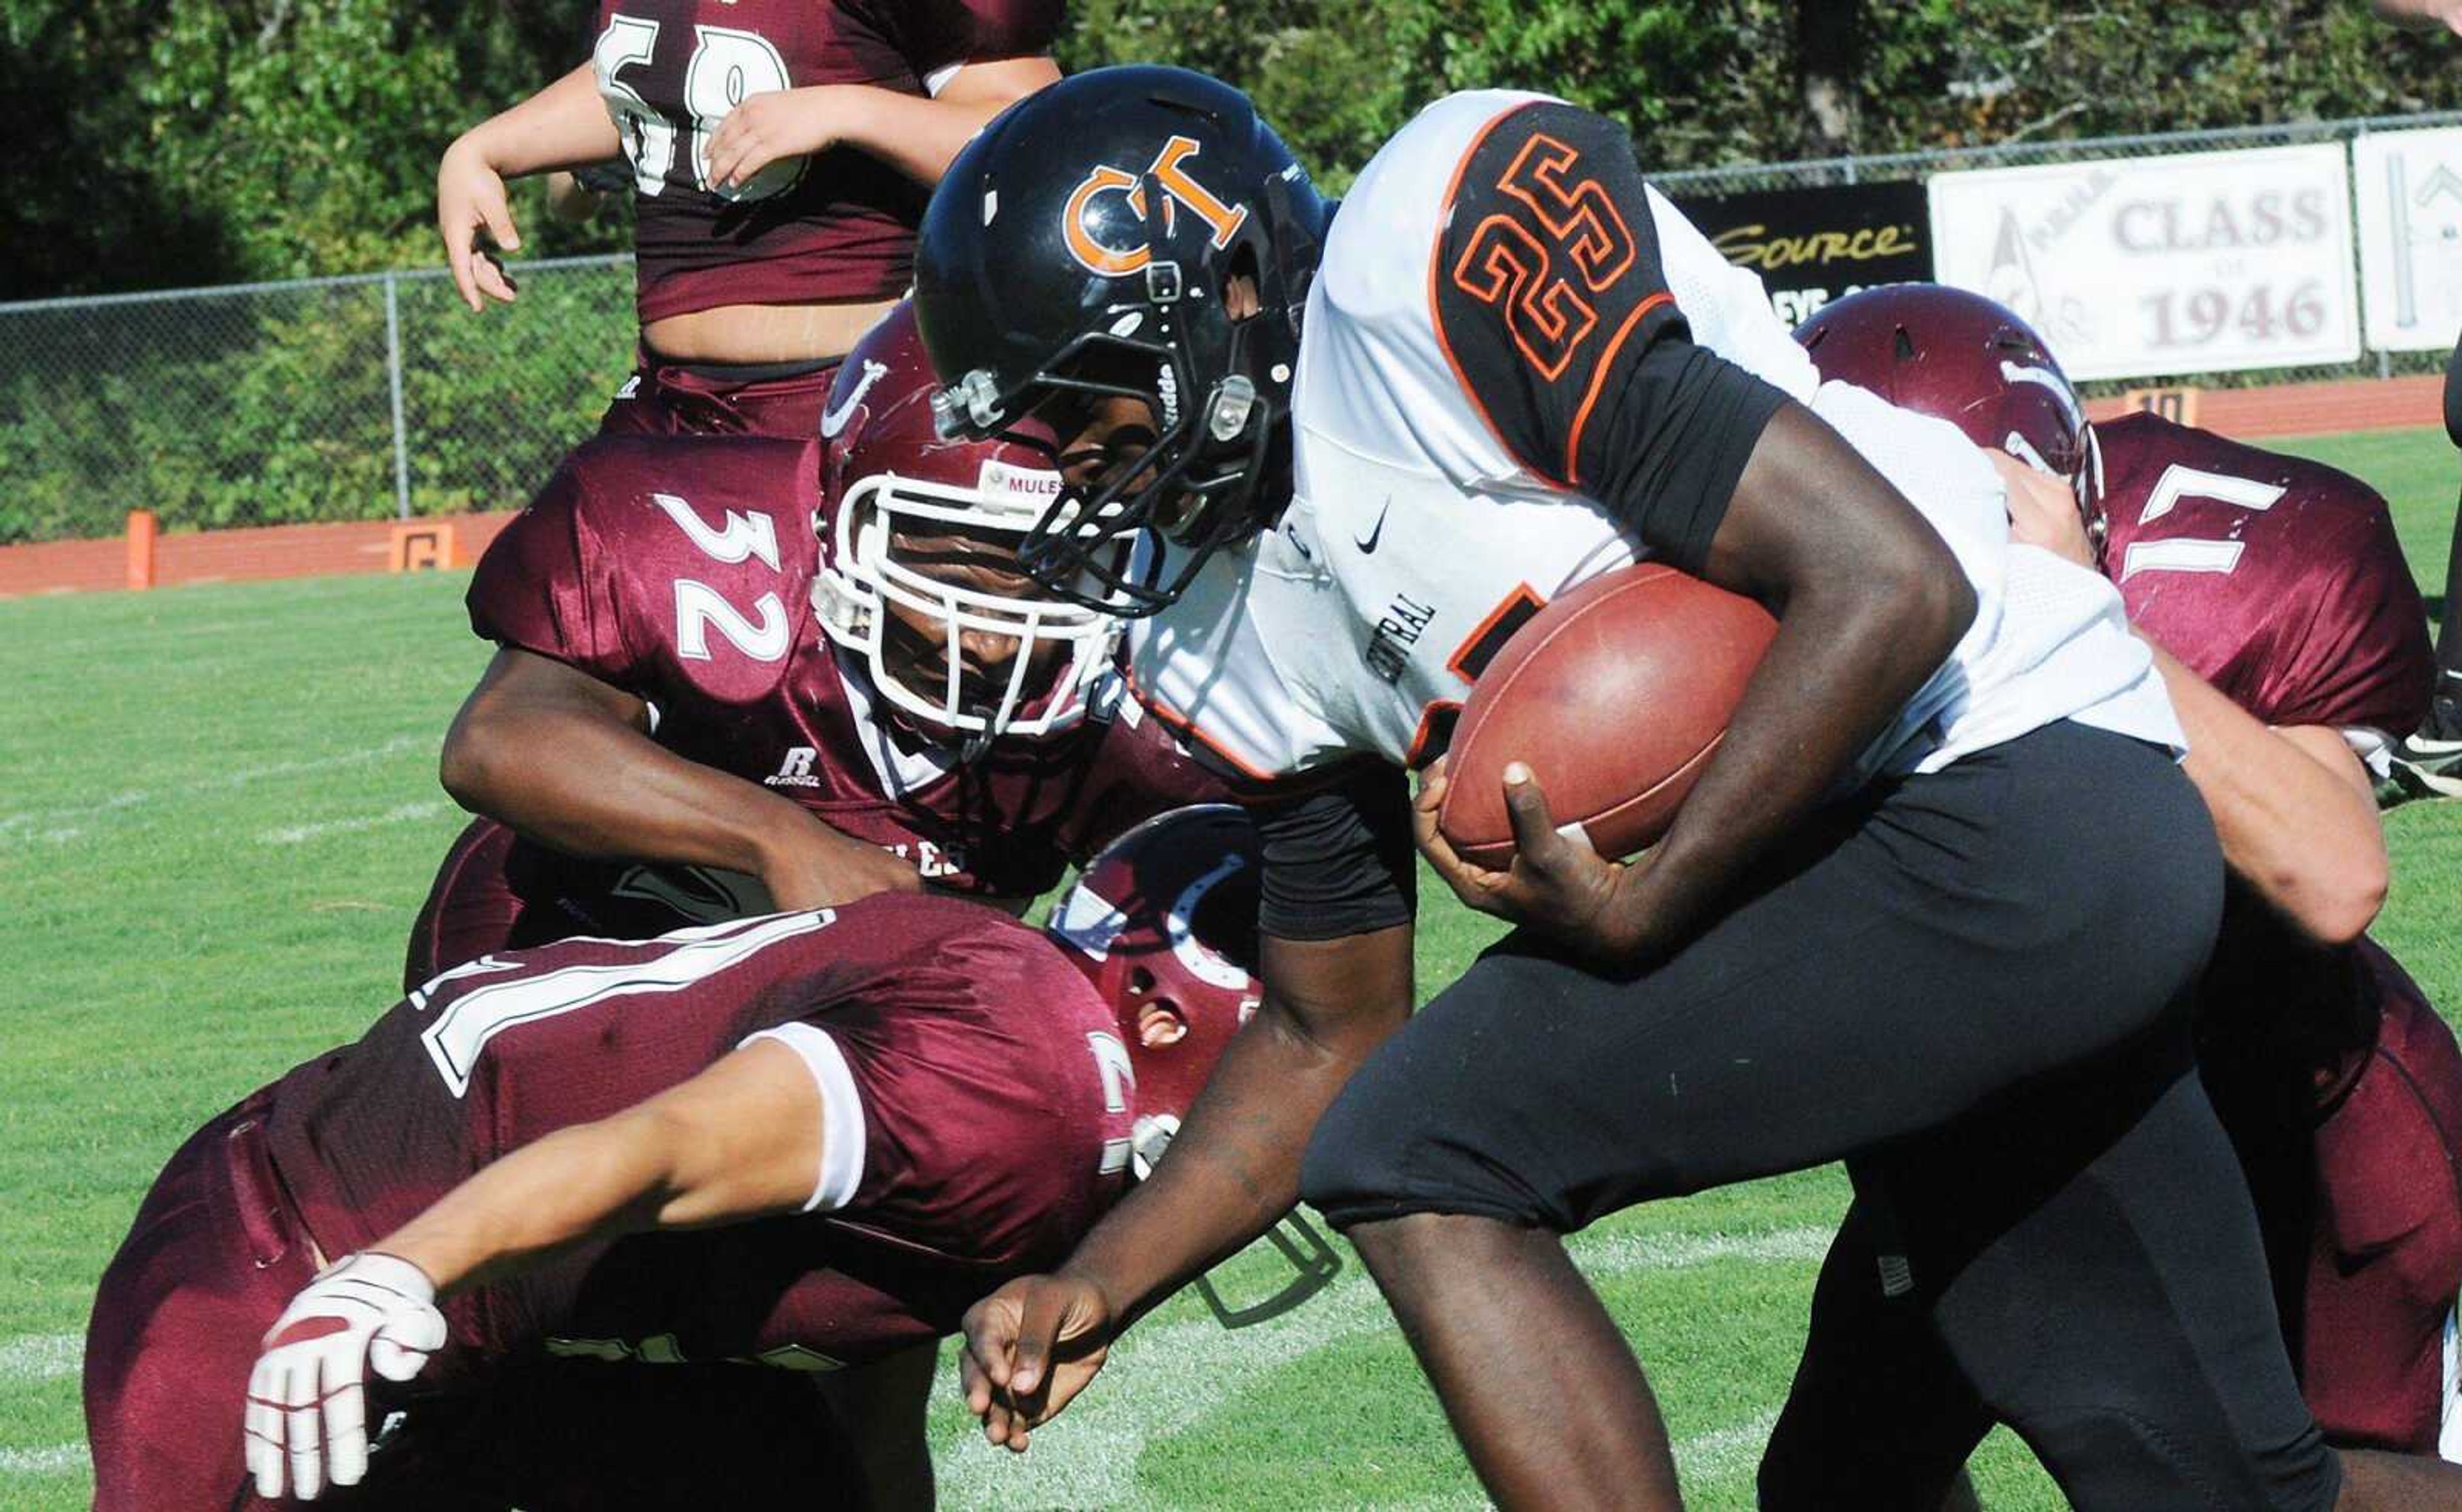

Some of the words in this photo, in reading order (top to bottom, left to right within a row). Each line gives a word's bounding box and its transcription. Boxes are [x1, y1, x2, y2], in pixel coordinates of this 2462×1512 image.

[1453, 132, 1637, 383] 25
[2114, 188, 2328, 252] CLASS
[2140, 278, 2325, 349] 1946
[653, 493, 789, 662] 32
[2118, 463, 2290, 584] 17
